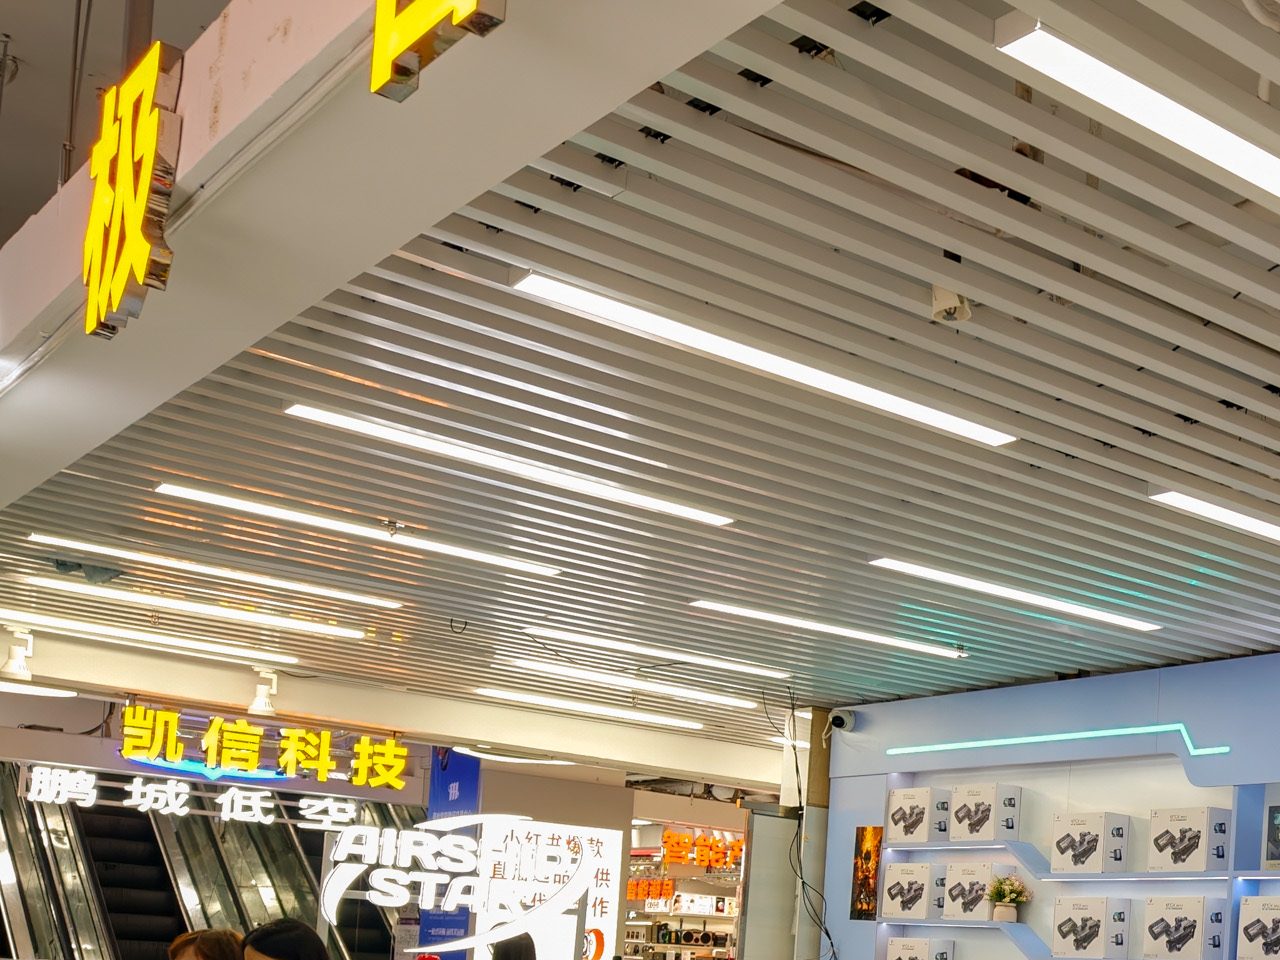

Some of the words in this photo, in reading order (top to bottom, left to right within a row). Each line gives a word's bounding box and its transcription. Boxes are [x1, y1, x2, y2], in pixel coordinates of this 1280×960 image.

[121, 705, 409, 790] 凯信科技
[27, 767, 358, 832] 鹏城低空
